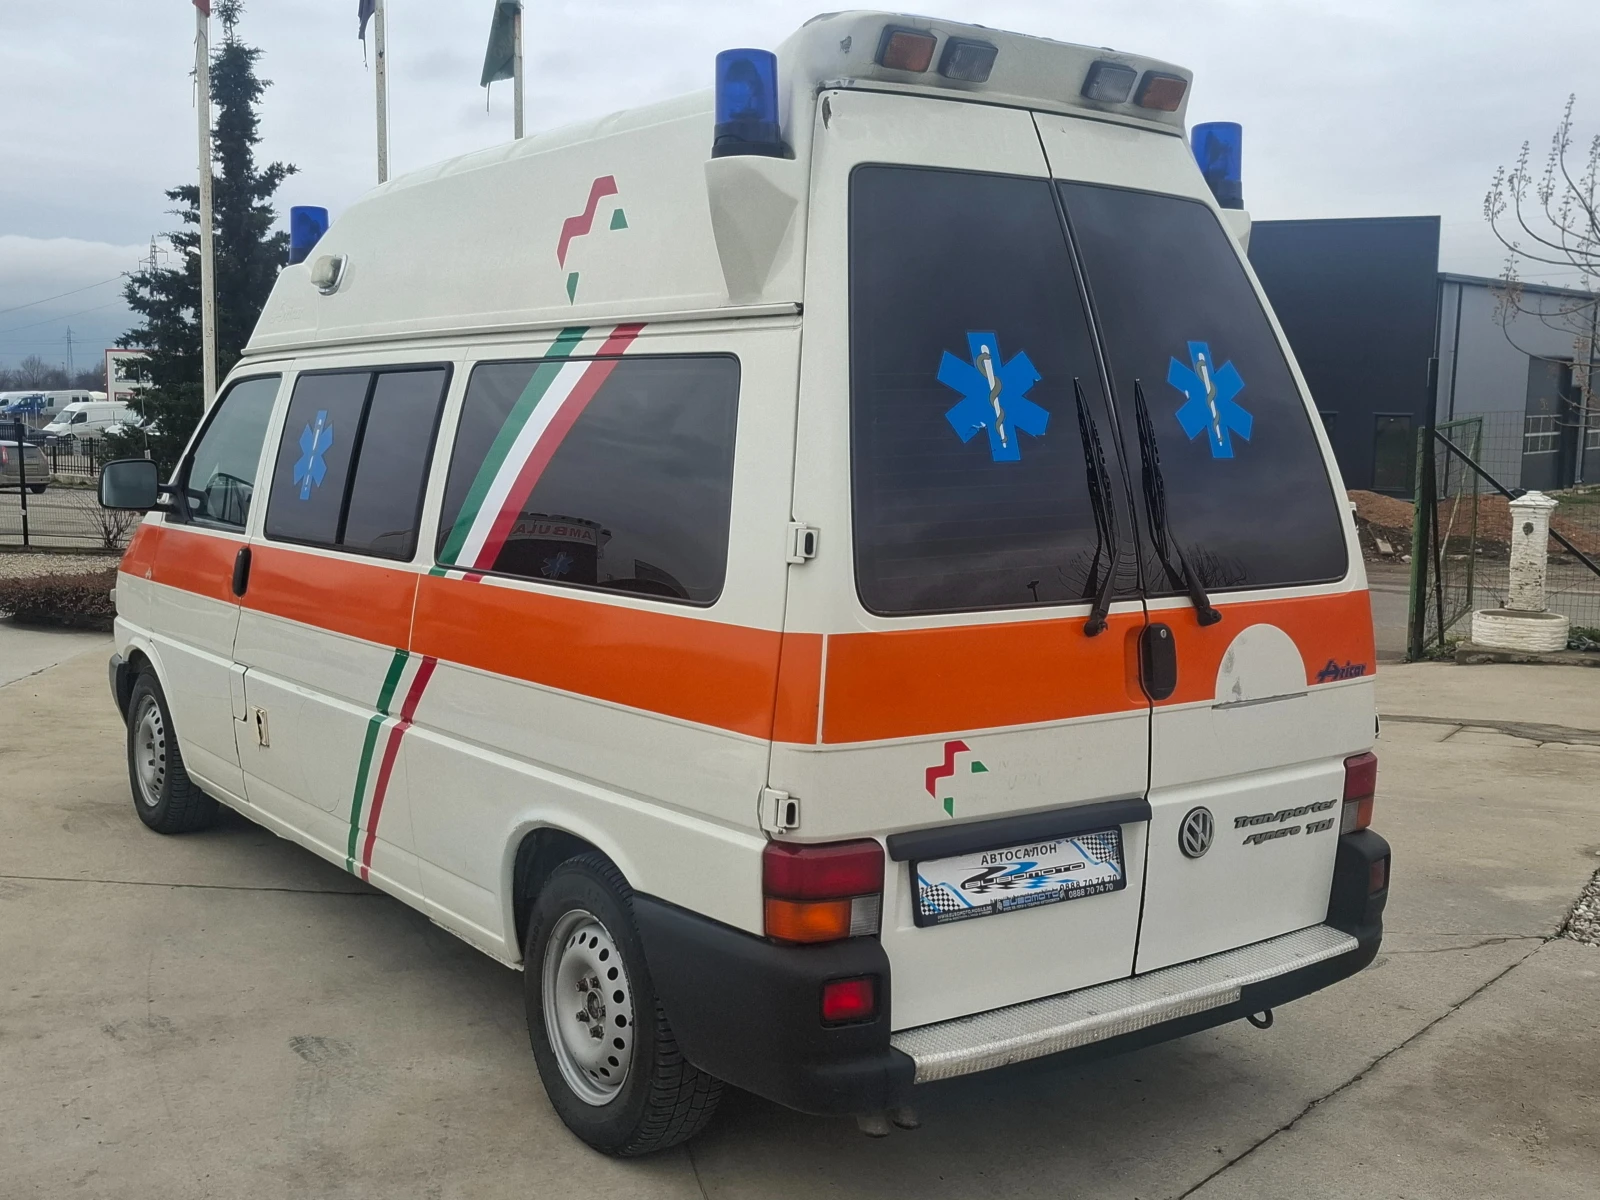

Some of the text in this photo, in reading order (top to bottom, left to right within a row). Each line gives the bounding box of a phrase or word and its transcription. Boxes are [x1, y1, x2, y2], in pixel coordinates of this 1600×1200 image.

[1234, 799, 1337, 829] Transporter
[1242, 818, 1335, 845] syncro TDI
[981, 843, 1058, 866] АВТОСАЛОН
[1068, 888, 1086, 899] 0888
[1086, 886, 1095, 895] 70
[1095, 884, 1105, 893] 74
[1105, 882, 1114, 891] 70
